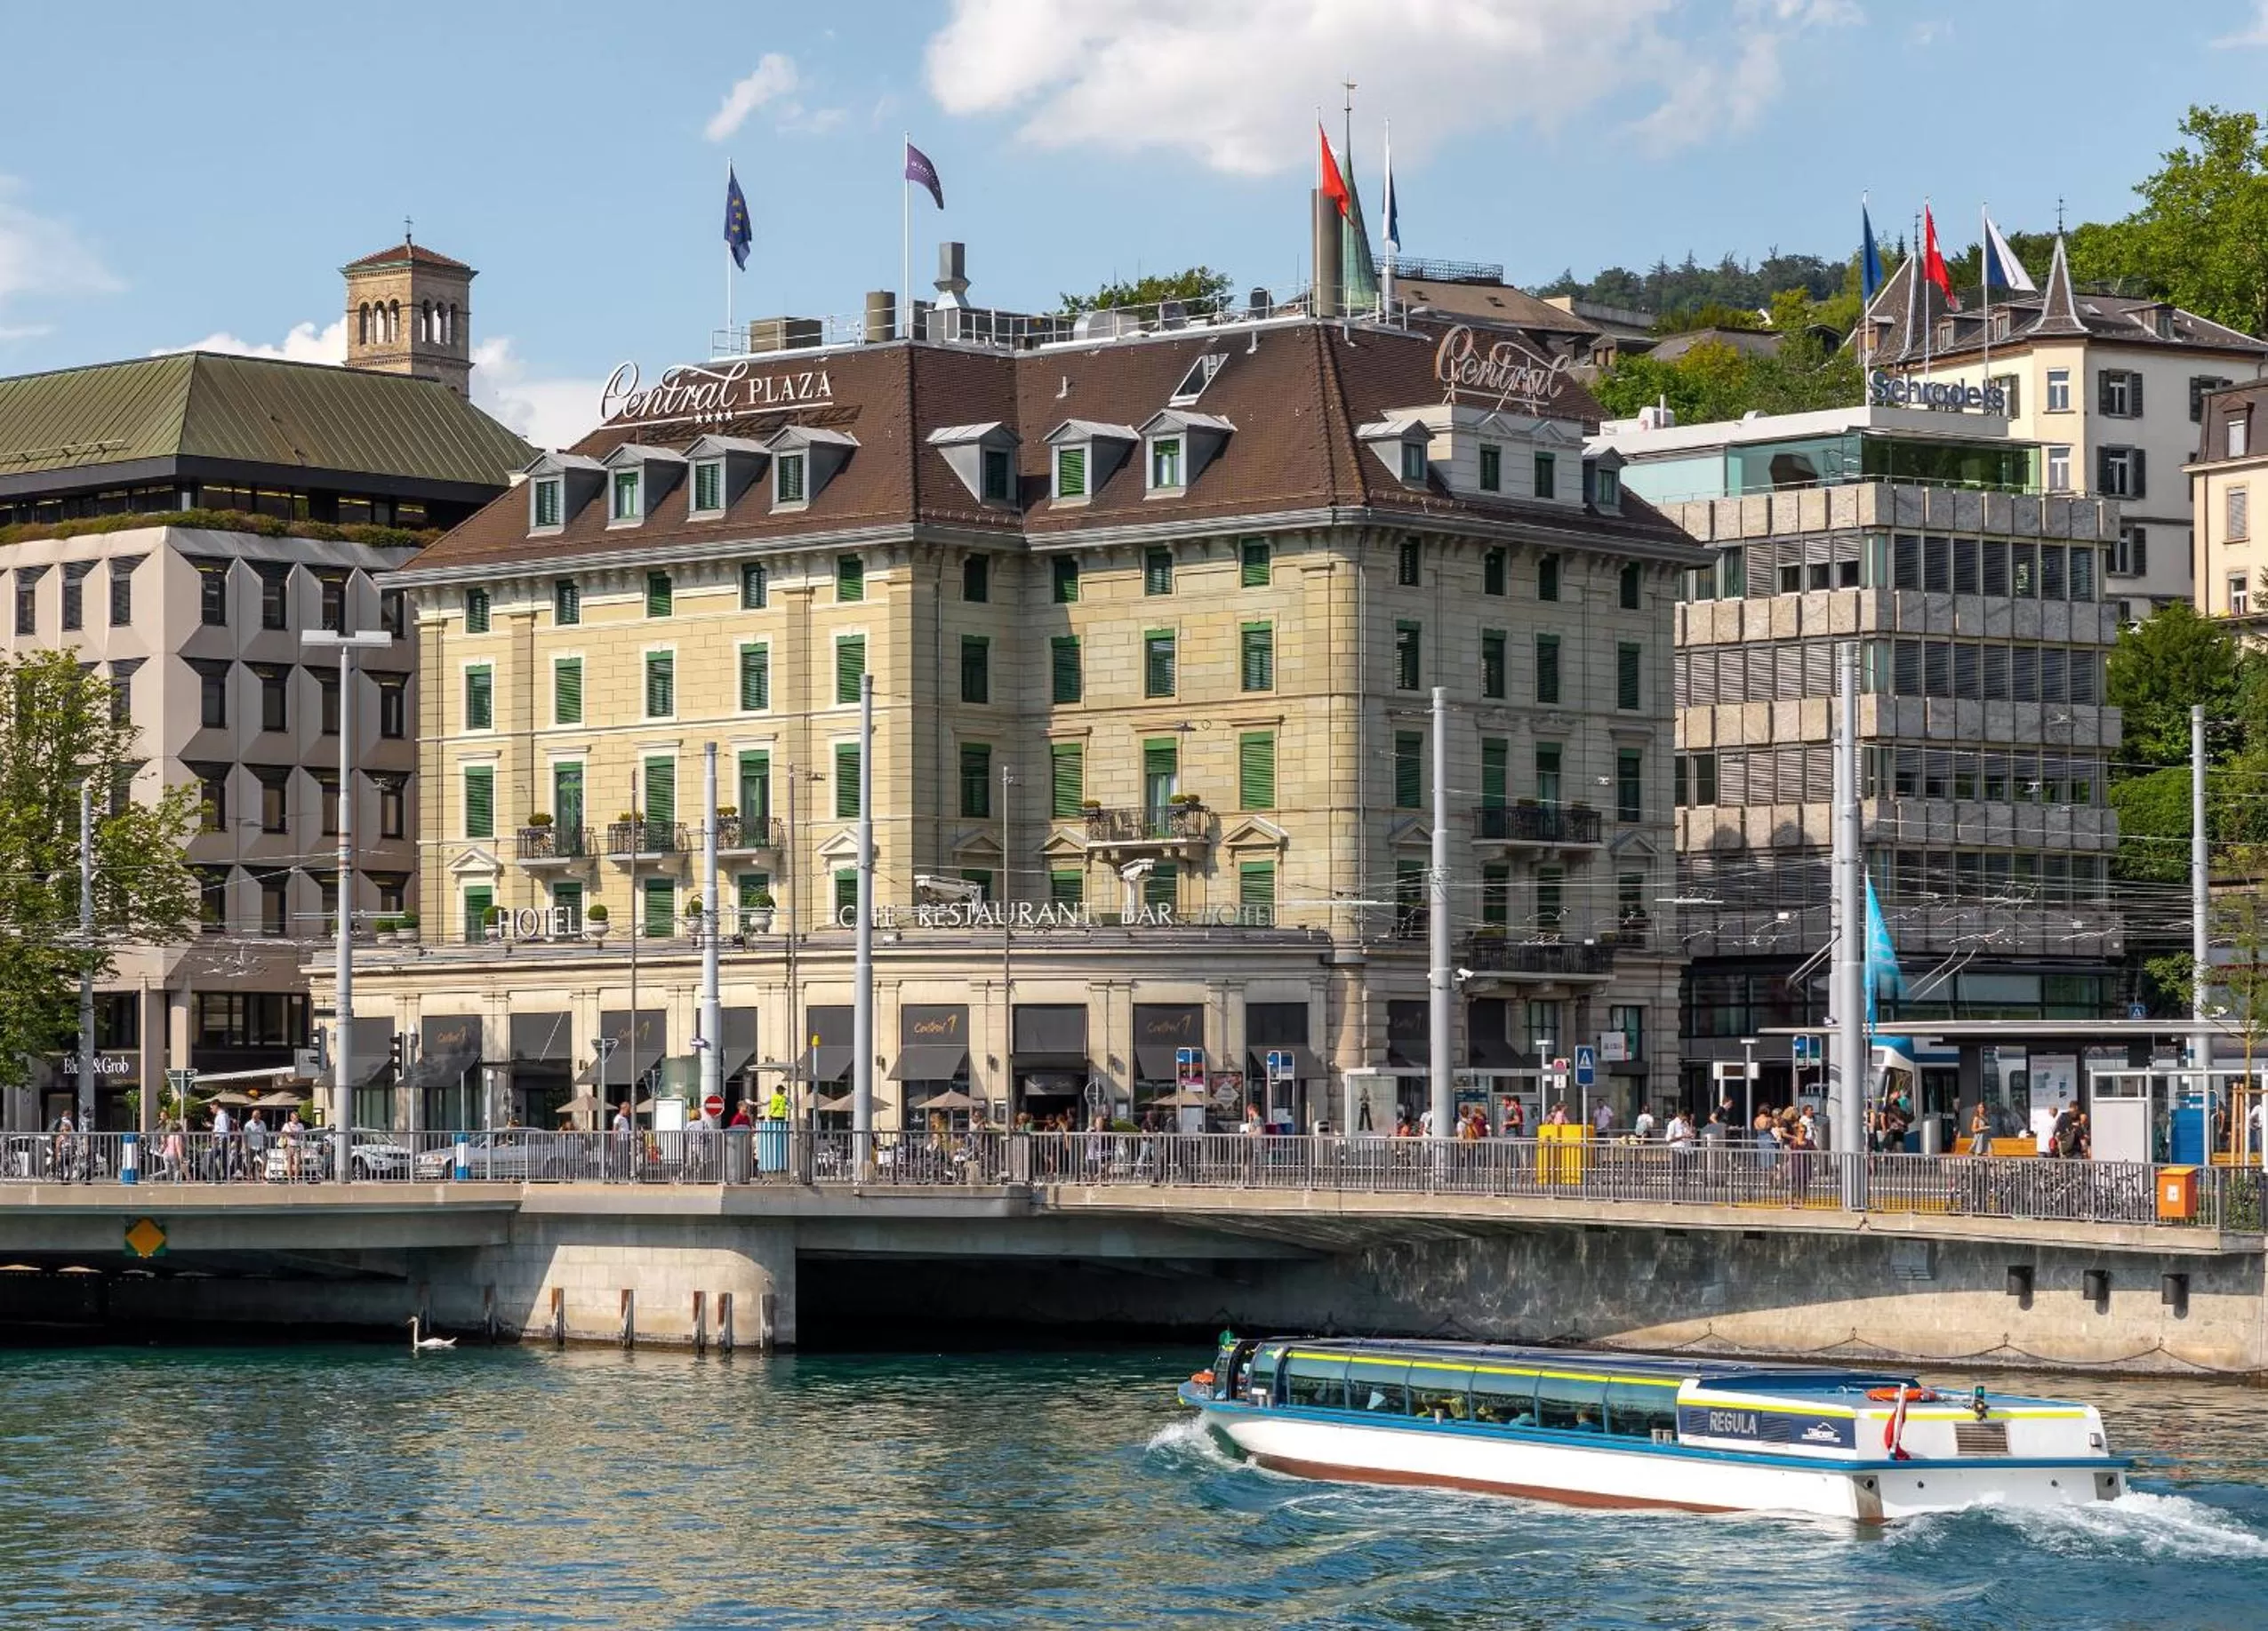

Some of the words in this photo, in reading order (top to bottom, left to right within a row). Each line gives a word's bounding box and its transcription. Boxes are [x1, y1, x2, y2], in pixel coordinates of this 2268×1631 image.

[1436, 324, 1570, 399] Central
[599, 360, 748, 422] Central
[749, 370, 833, 404] PLAZA
[1869, 370, 2006, 410] Schroders
[498, 907, 579, 939] HOTEL
[918, 901, 1094, 927] RESTAURANT
[1121, 901, 1174, 925] BAR
[1709, 1411, 1758, 1435] REGULA
